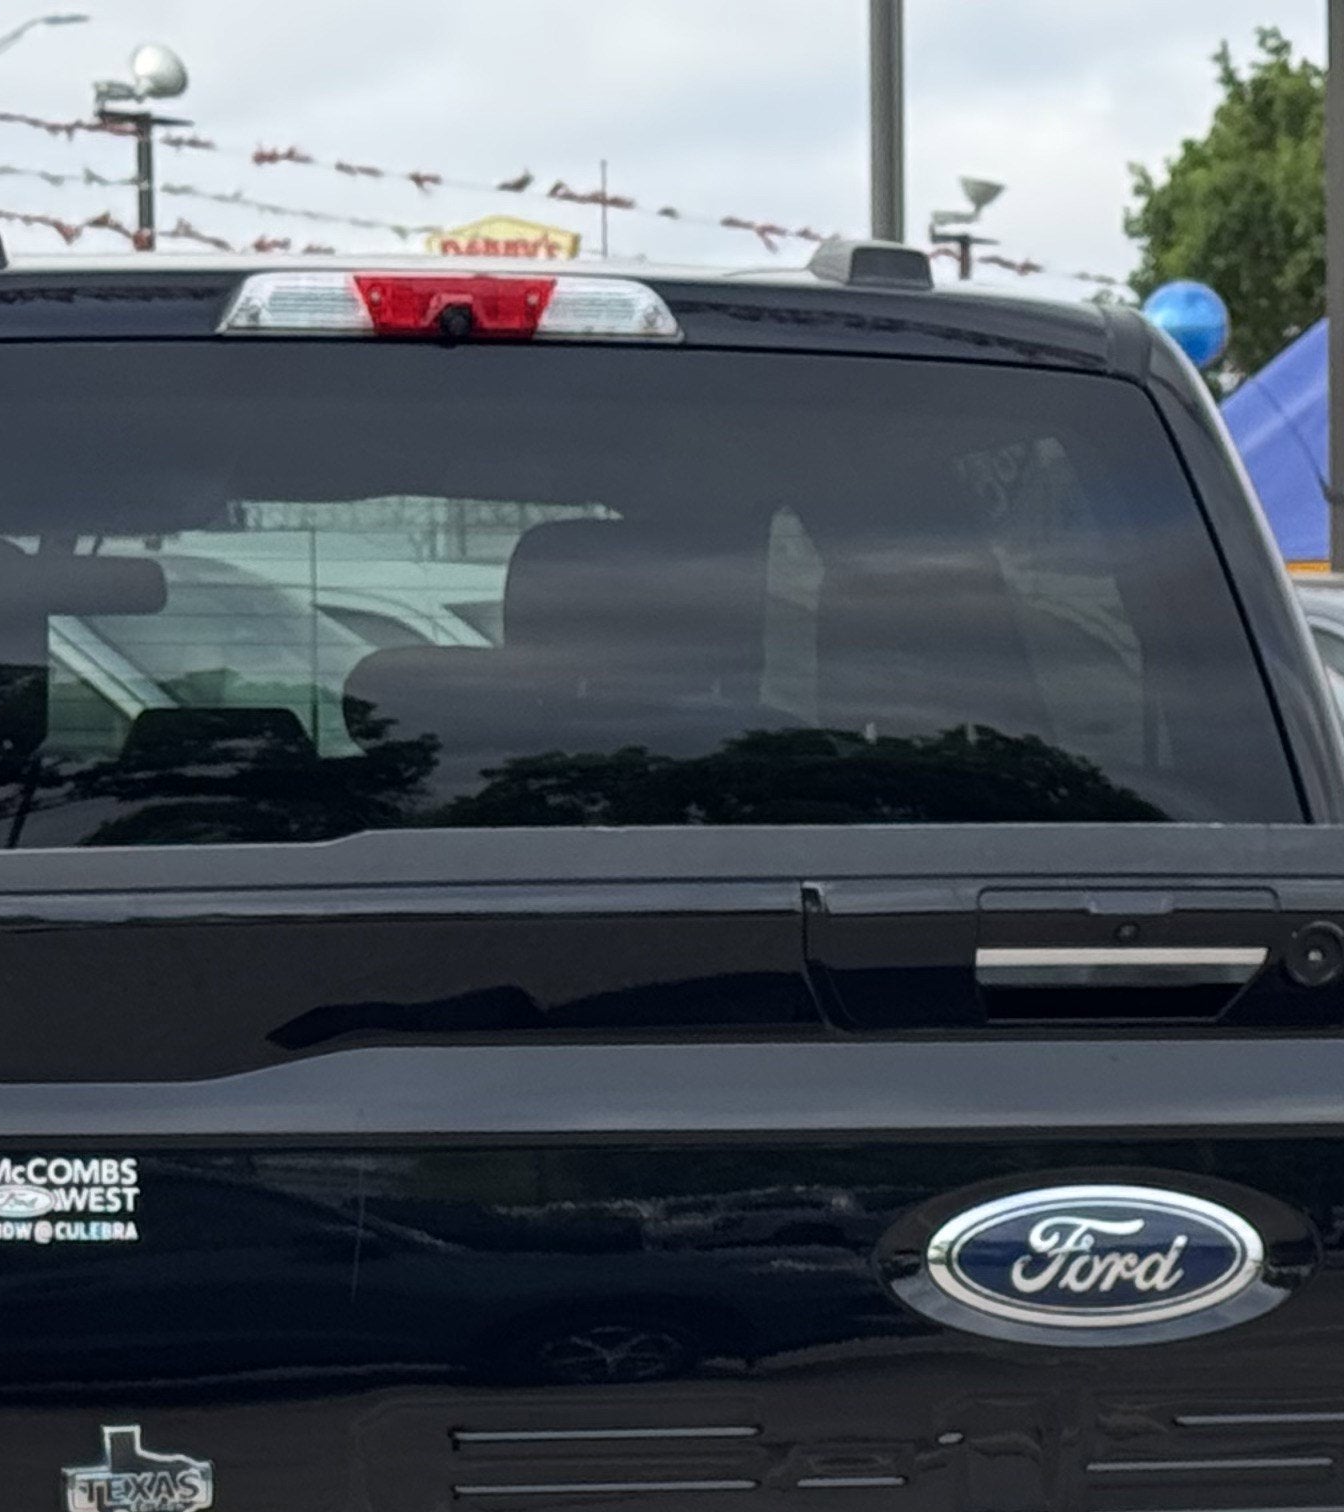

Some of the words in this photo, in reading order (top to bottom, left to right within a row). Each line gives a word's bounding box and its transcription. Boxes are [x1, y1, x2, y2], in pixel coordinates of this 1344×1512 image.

[57, 1186, 140, 1212] WEST
[1011, 1215, 1188, 1293] Ford
[76, 1471, 201, 1504] TEXAS
